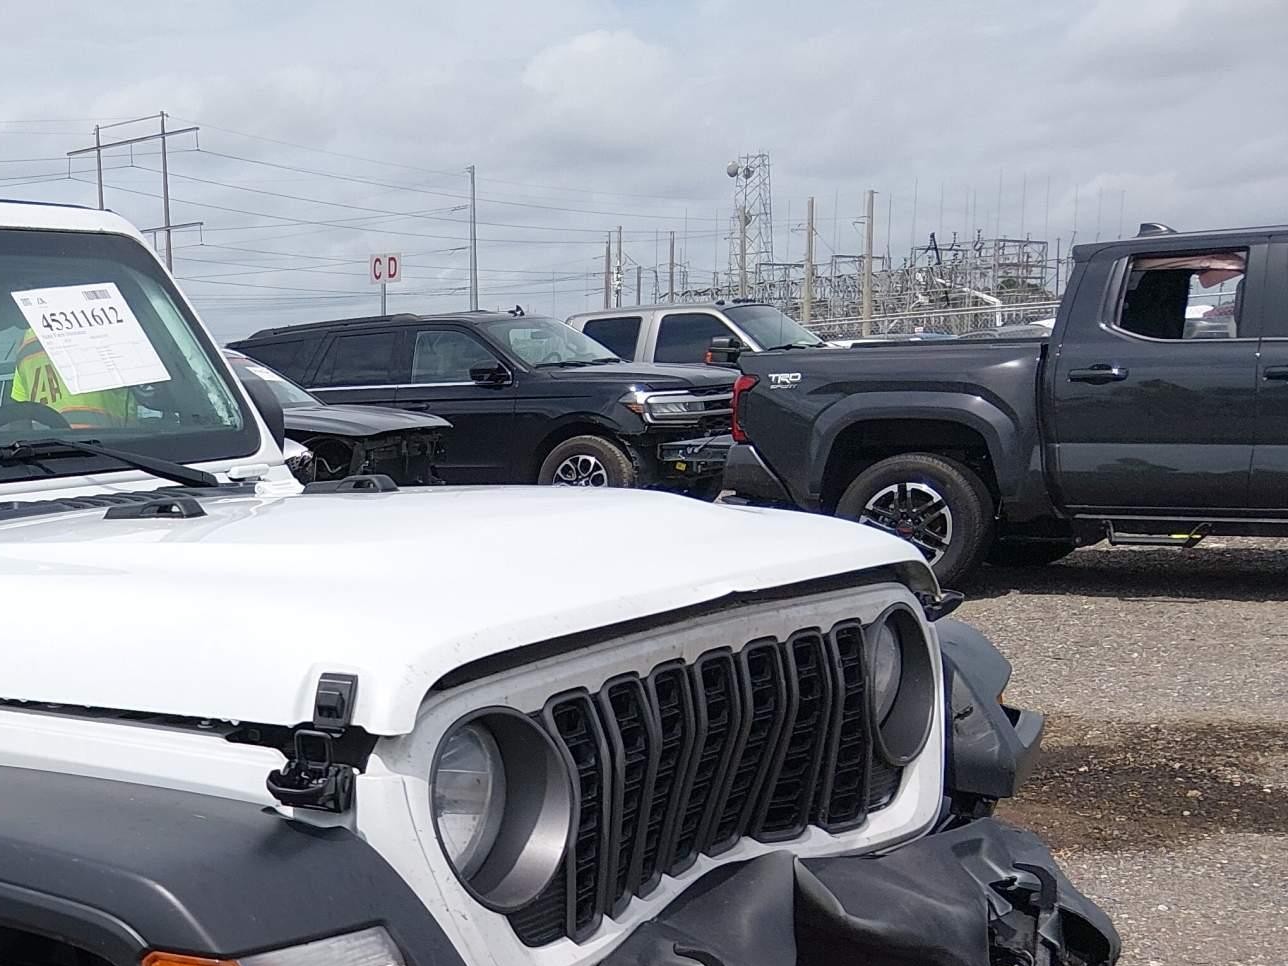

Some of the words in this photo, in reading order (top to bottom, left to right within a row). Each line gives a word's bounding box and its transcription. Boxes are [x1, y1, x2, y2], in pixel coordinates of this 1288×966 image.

[373, 257, 382, 280] C
[388, 256, 397, 279] D
[41, 306, 124, 332] 45311612
[768, 373, 801, 384] TRD
